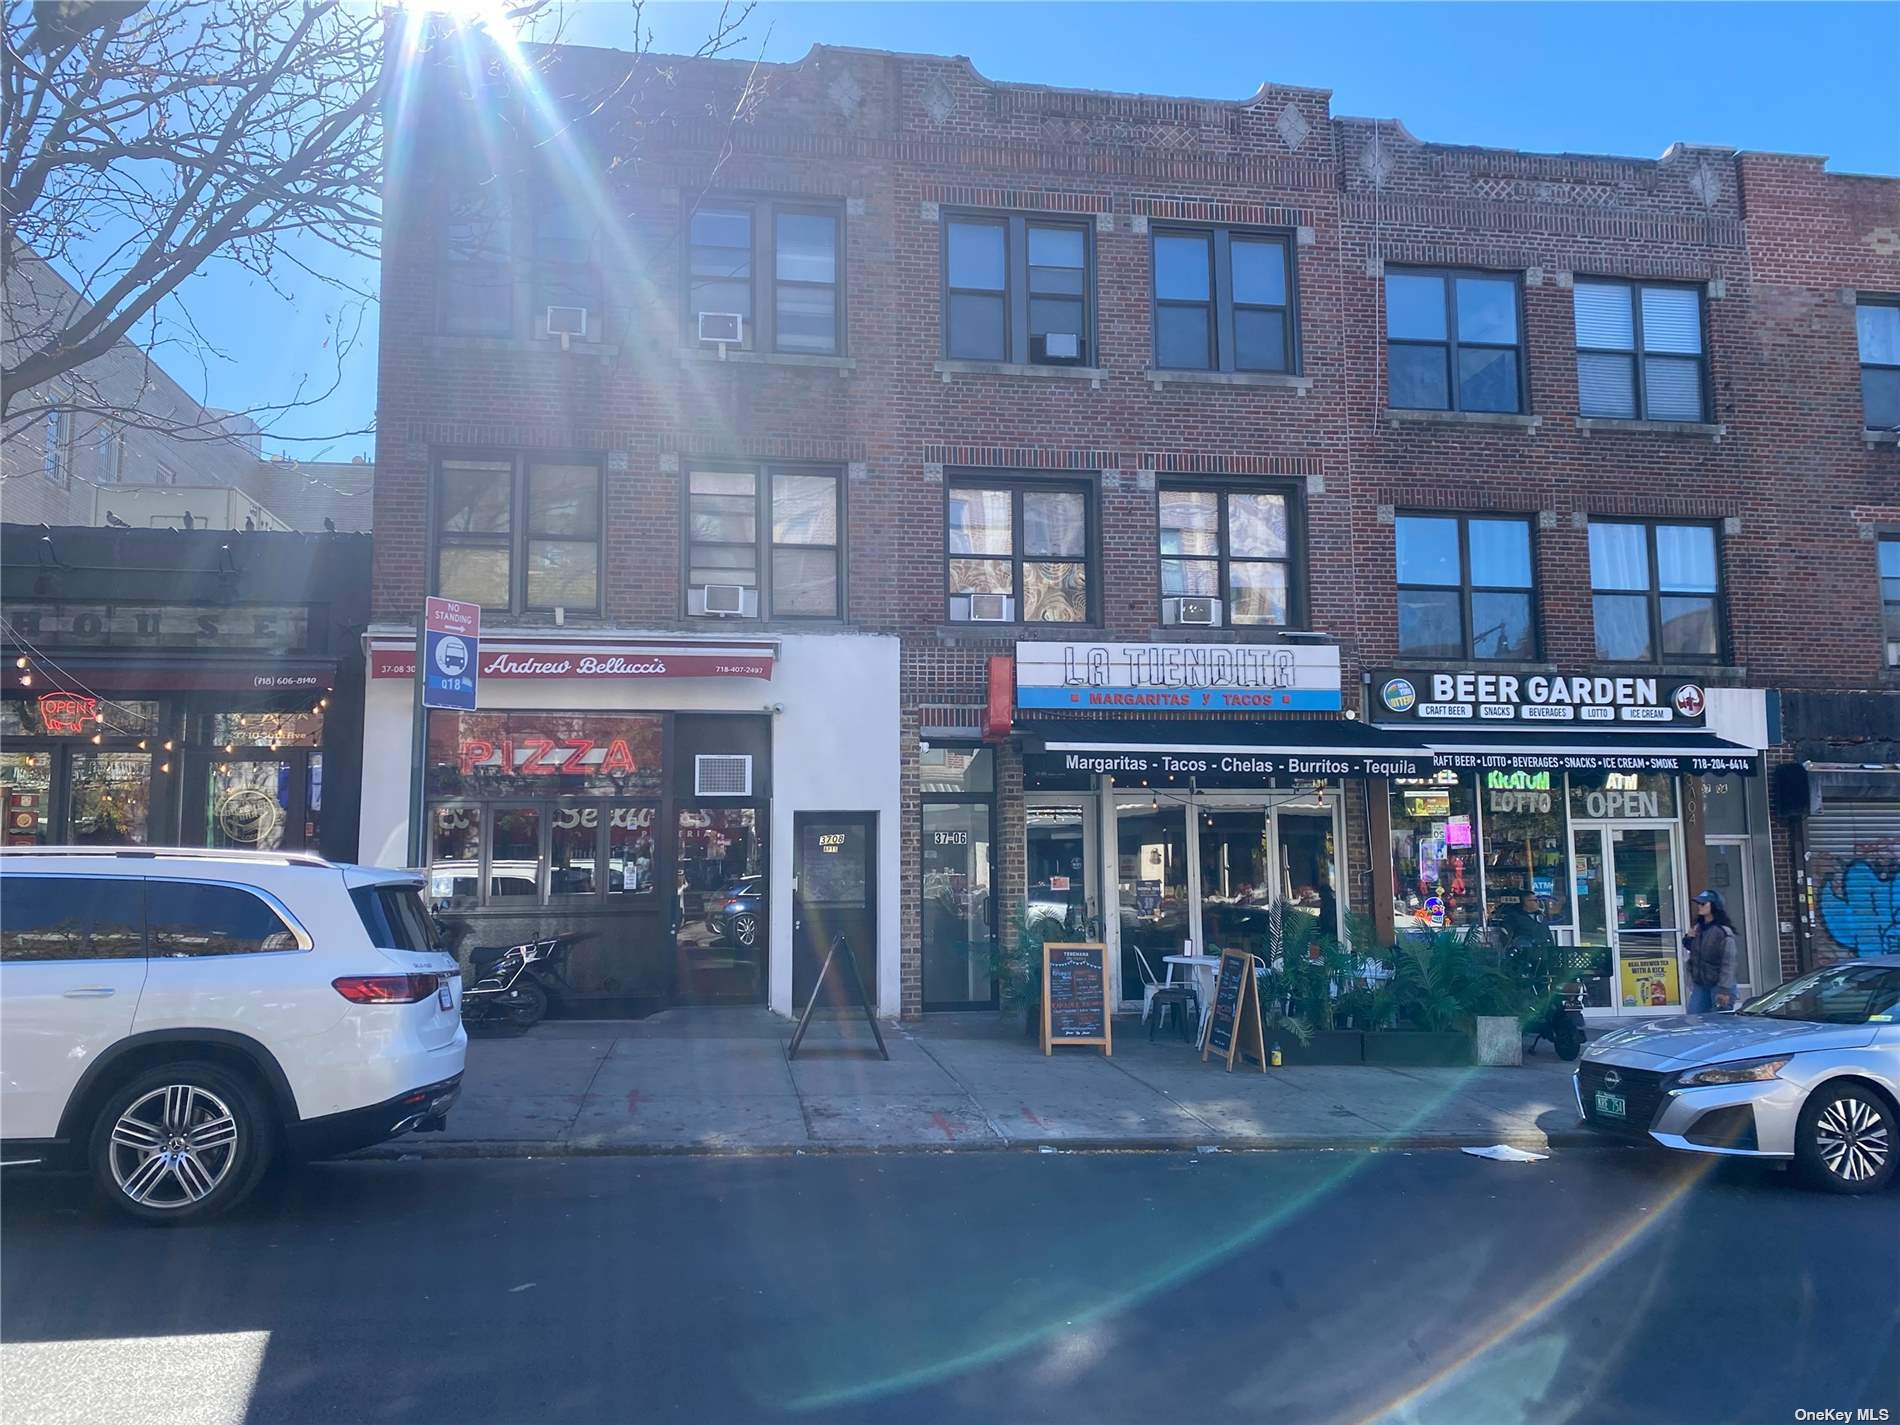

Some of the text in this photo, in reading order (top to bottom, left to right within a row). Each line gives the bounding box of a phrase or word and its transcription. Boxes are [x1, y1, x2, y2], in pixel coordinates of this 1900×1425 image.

[447, 602, 460, 612] NO
[434, 610, 472, 625] STANDING
[382, 664, 404, 673] 37-08
[484, 653, 573, 675] Andrew
[715, 664, 764, 675] 718-407-2497
[1063, 647, 1296, 688] LA TIENDITA
[253, 674, 317, 687] (718) 606-8140
[442, 679, 461, 690] Q18
[1433, 674, 1657, 705] BEER GARDEN
[1089, 692, 1190, 705] MARGARITAS
[1223, 694, 1272, 706] TACOS
[45, 700, 88, 714] OPEN
[1425, 705, 1466, 716] CRAFT BEER
[1483, 706, 1511, 717] SNACKS
[1528, 707, 1567, 718] BEVERAGES
[1587, 708, 1608, 719] LOTTO
[1630, 710, 1664, 720] ICE CREAM
[459, 737, 637, 776] PIZZA
[1433, 755, 1749, 770] RAFT BEER LOTTO BEVERAGES SNACKS ICE CREAM SMOKE 718-204-6414
[1066, 753, 1416, 776] Margaritas Tacos Chelas Burritos Tequila
[1605, 772, 1638, 791] ATM
[1490, 790, 1551, 813] LOTTO
[1586, 791, 1659, 818] OPEN
[820, 834, 845, 845] 3708
[934, 832, 967, 844] 37-06
